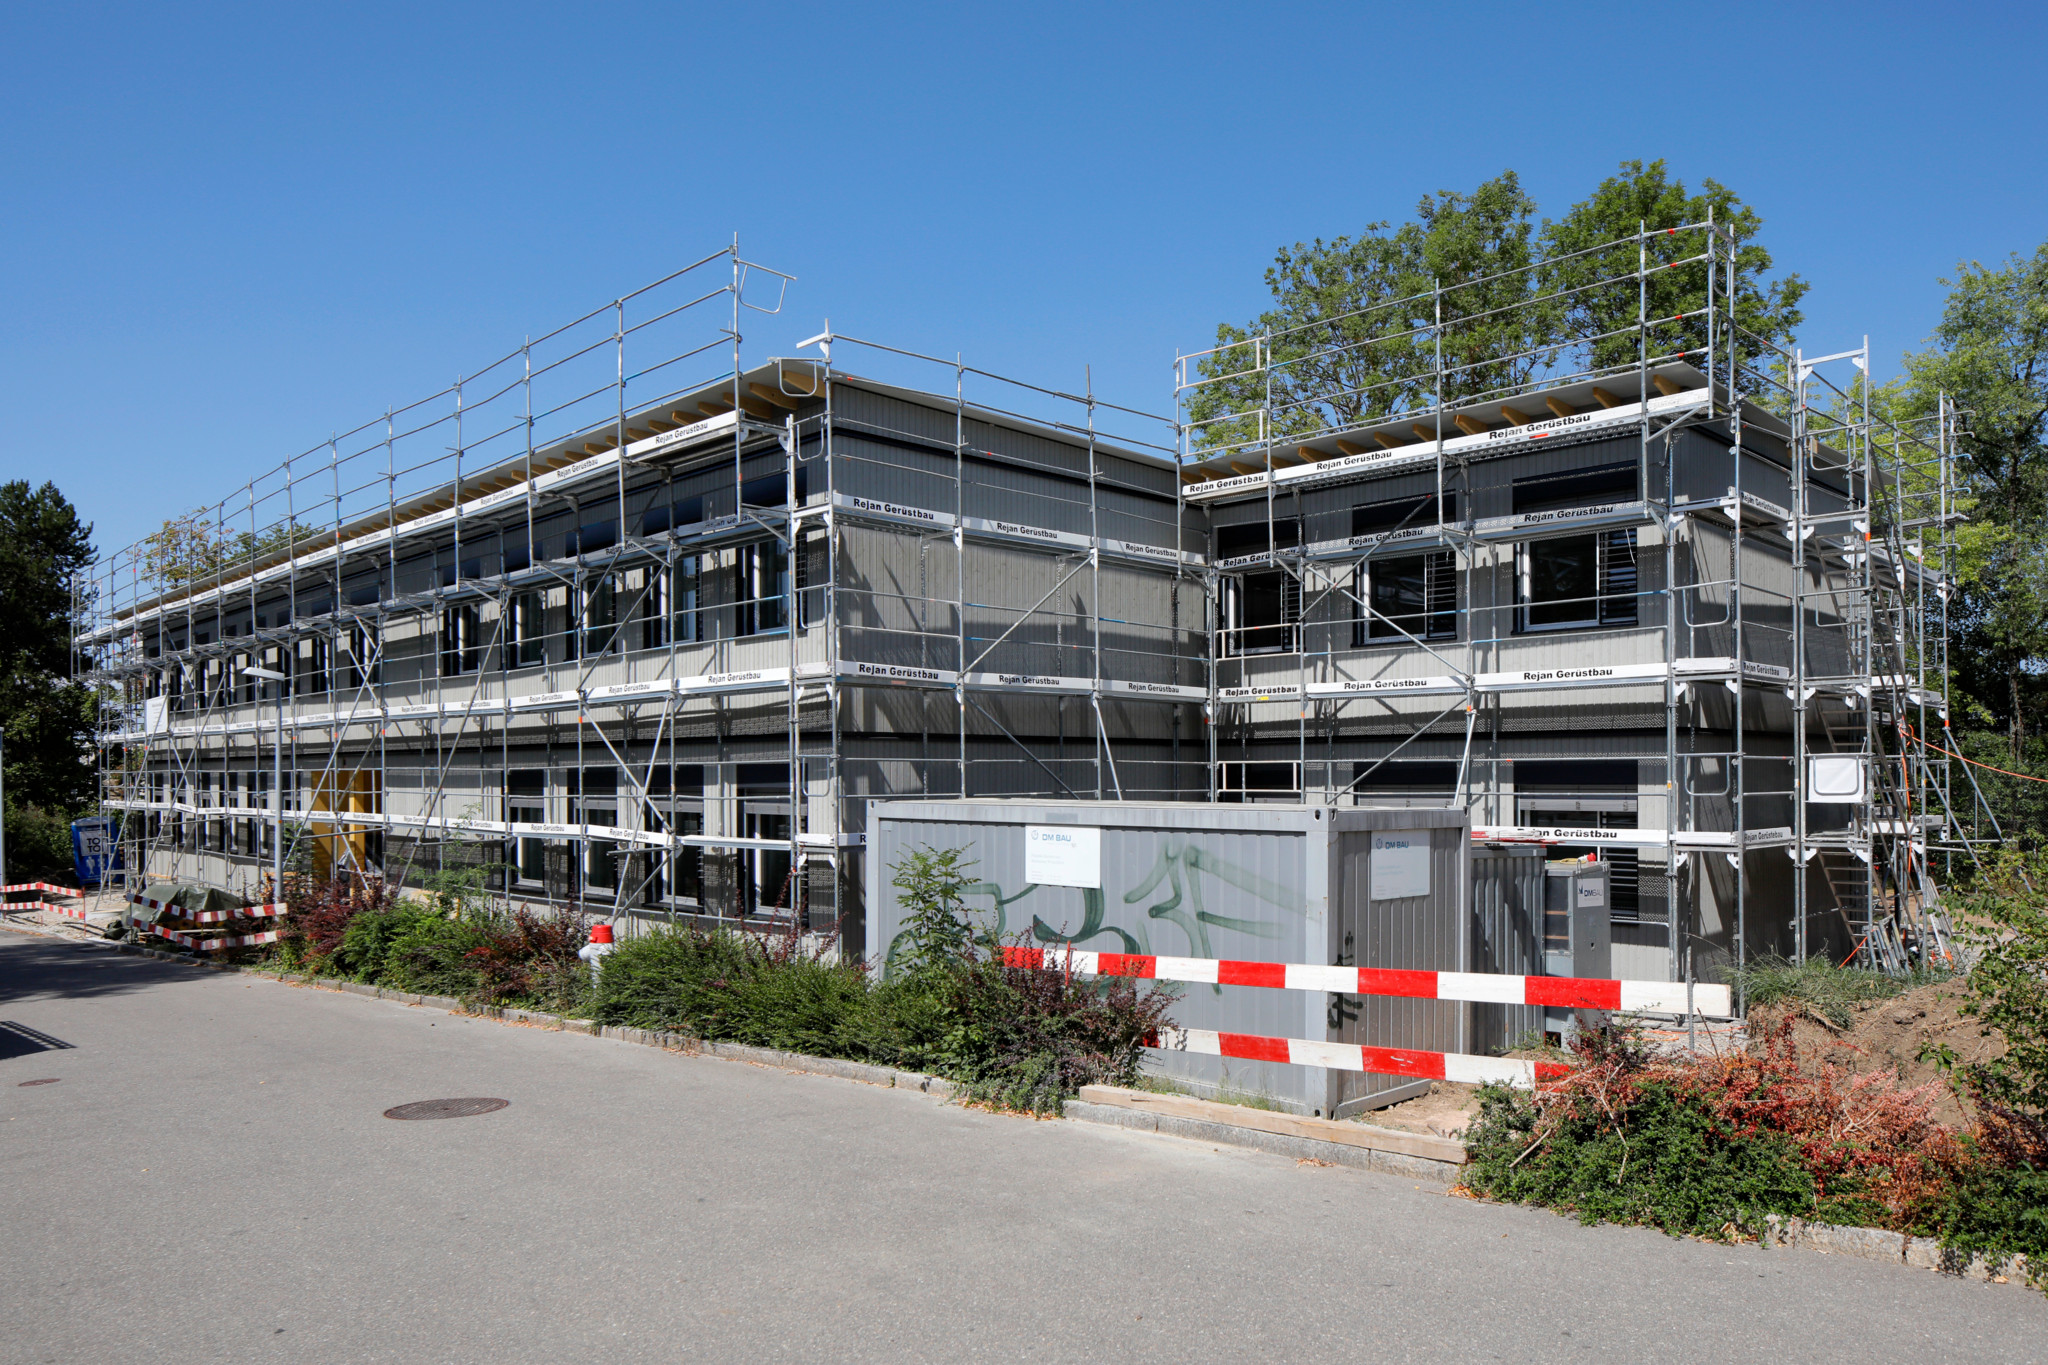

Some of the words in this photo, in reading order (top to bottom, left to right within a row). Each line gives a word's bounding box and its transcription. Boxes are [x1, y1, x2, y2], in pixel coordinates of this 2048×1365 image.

[1489, 427, 1523, 440] Rejan
[1526, 414, 1591, 434] Gerüstbau
[655, 433, 673, 445] Rejan
[675, 422, 708, 438] Gerüstbau
[1316, 459, 1342, 471] Rejan
[1344, 450, 1392, 467] Gerüstbau
[556, 467, 571, 479] Rejan
[572, 459, 599, 473] Gerüstbau
[1189, 481, 1215, 493] Rejan
[1216, 474, 1264, 489] Gerüstbau
[853, 498, 881, 511] Rejan
[884, 504, 934, 520] Gerüstbau
[1524, 511, 1554, 523] Rejan
[1556, 505, 1614, 520] Gerüstbau
[997, 523, 1018, 534] Rejan
[1020, 526, 1058, 539] Gerüstbau
[1348, 536, 1373, 546] Rejan
[1125, 543, 1144, 553] Rejan
[1145, 547, 1177, 558] Gerüstbau
[1223, 557, 1247, 567] Rejan
[708, 675, 726, 684] Rejan
[727, 672, 761, 682] Gerüstbau
[859, 664, 887, 676] Rejan
[889, 667, 939, 680] Gerüstbau
[1523, 672, 1553, 682] Rejan
[1556, 667, 1613, 679] Gerüstbau
[999, 675, 1020, 685] Rejan
[1022, 676, 1060, 686] Gerüstbau
[1343, 681, 1372, 691] Rejan
[1374, 679, 1427, 689] Gerüstbau
[608, 686, 623, 694] Rejan
[623, 683, 651, 692] Gerüstbau
[1128, 683, 1146, 692] Rejan
[1147, 684, 1180, 694] Gerüstbau
[1225, 688, 1249, 697] Rejan
[1251, 685, 1298, 695] Gerüstbau
[609, 828, 623, 837] Rejan
[1042, 833, 1054, 841] DM
[1055, 834, 1072, 842] BAU
[1554, 828, 1618, 839] Gerüstbau
[1385, 841, 1396, 850] DM
[1396, 840, 1410, 849] BAU
